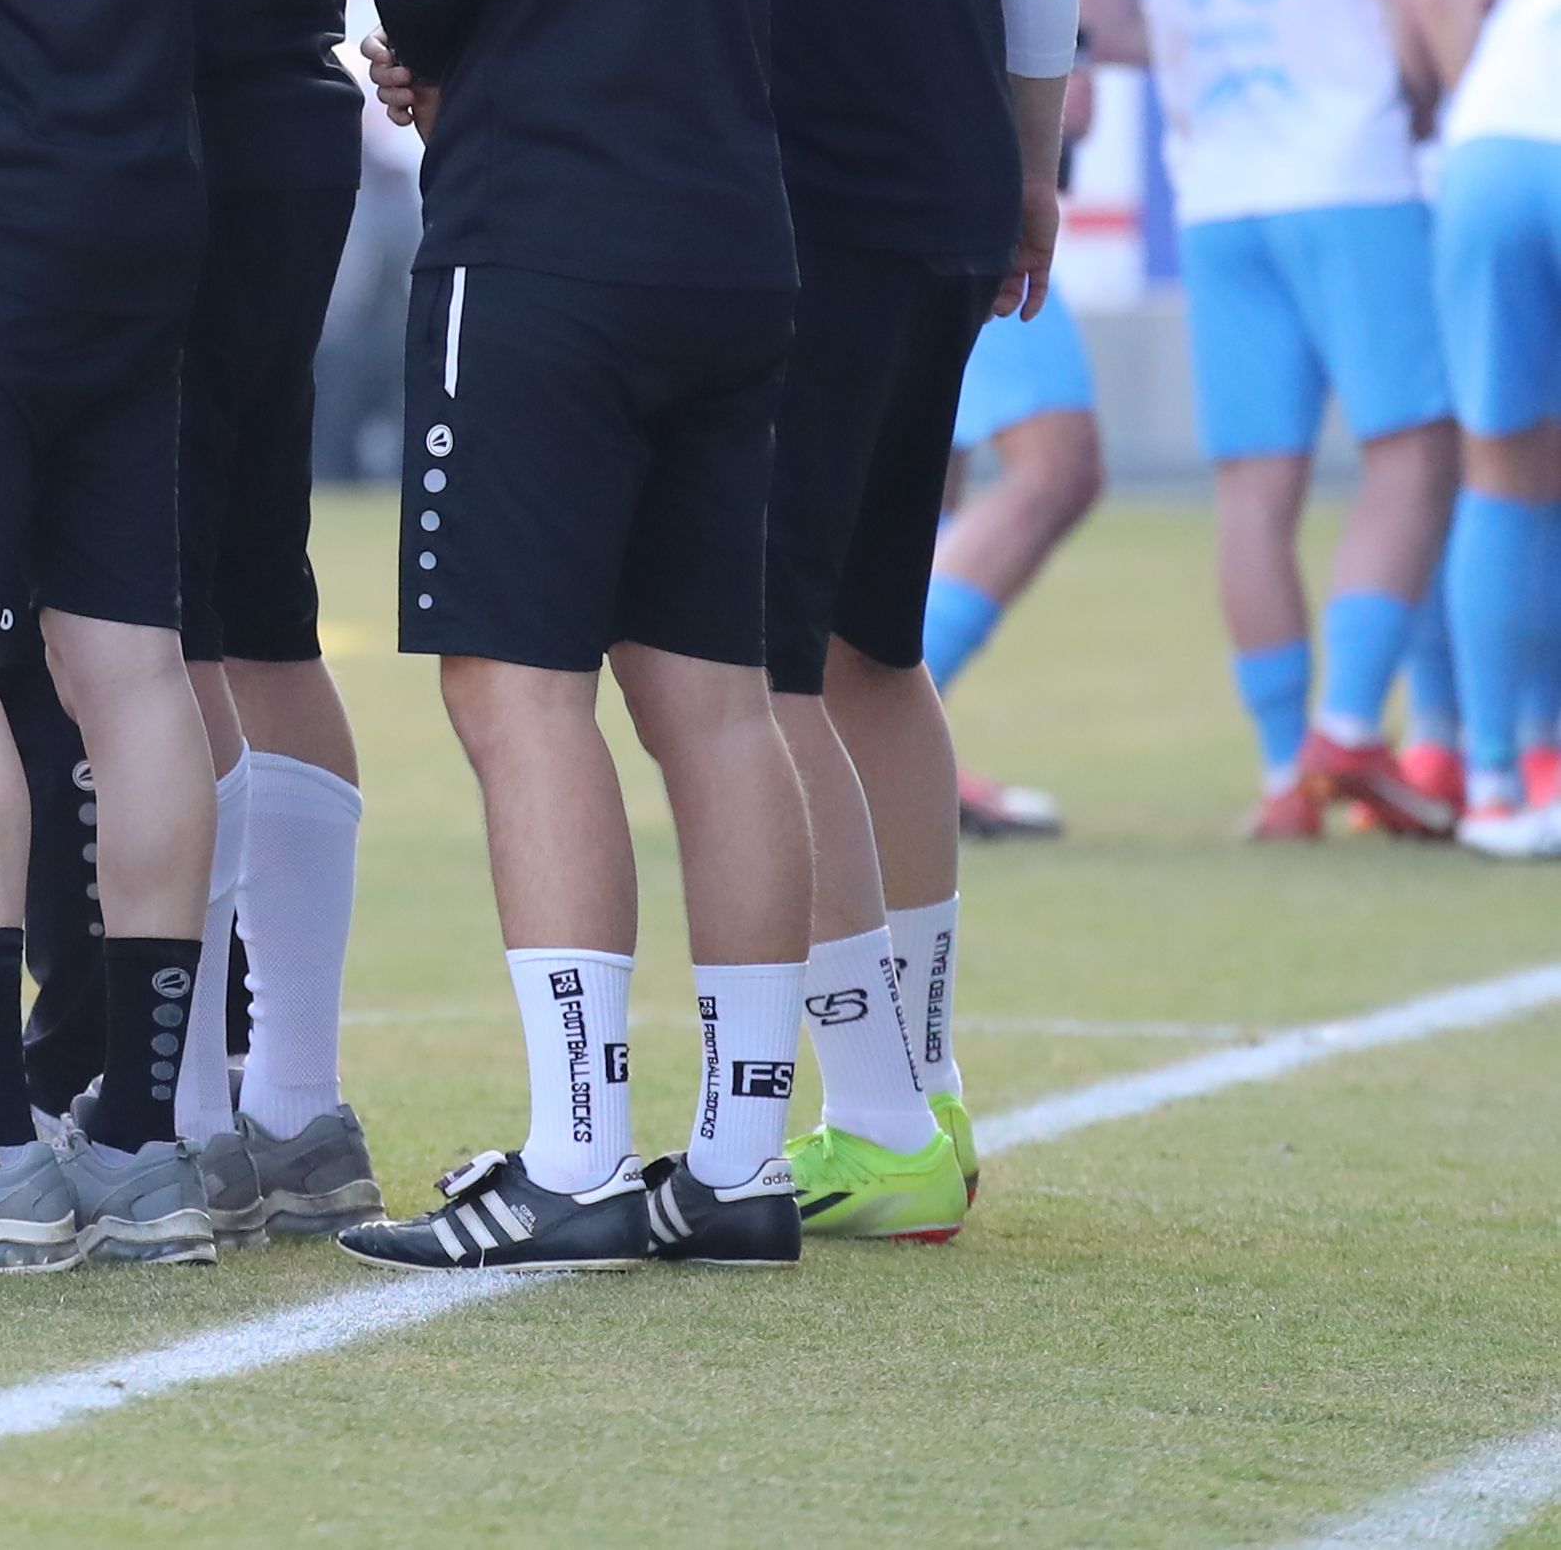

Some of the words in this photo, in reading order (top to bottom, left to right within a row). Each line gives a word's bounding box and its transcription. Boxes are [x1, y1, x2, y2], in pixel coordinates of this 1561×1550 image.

[552, 972, 578, 994] FS
[926, 979, 945, 1063] CERTIFIED
[741, 1063, 793, 1096] FS
